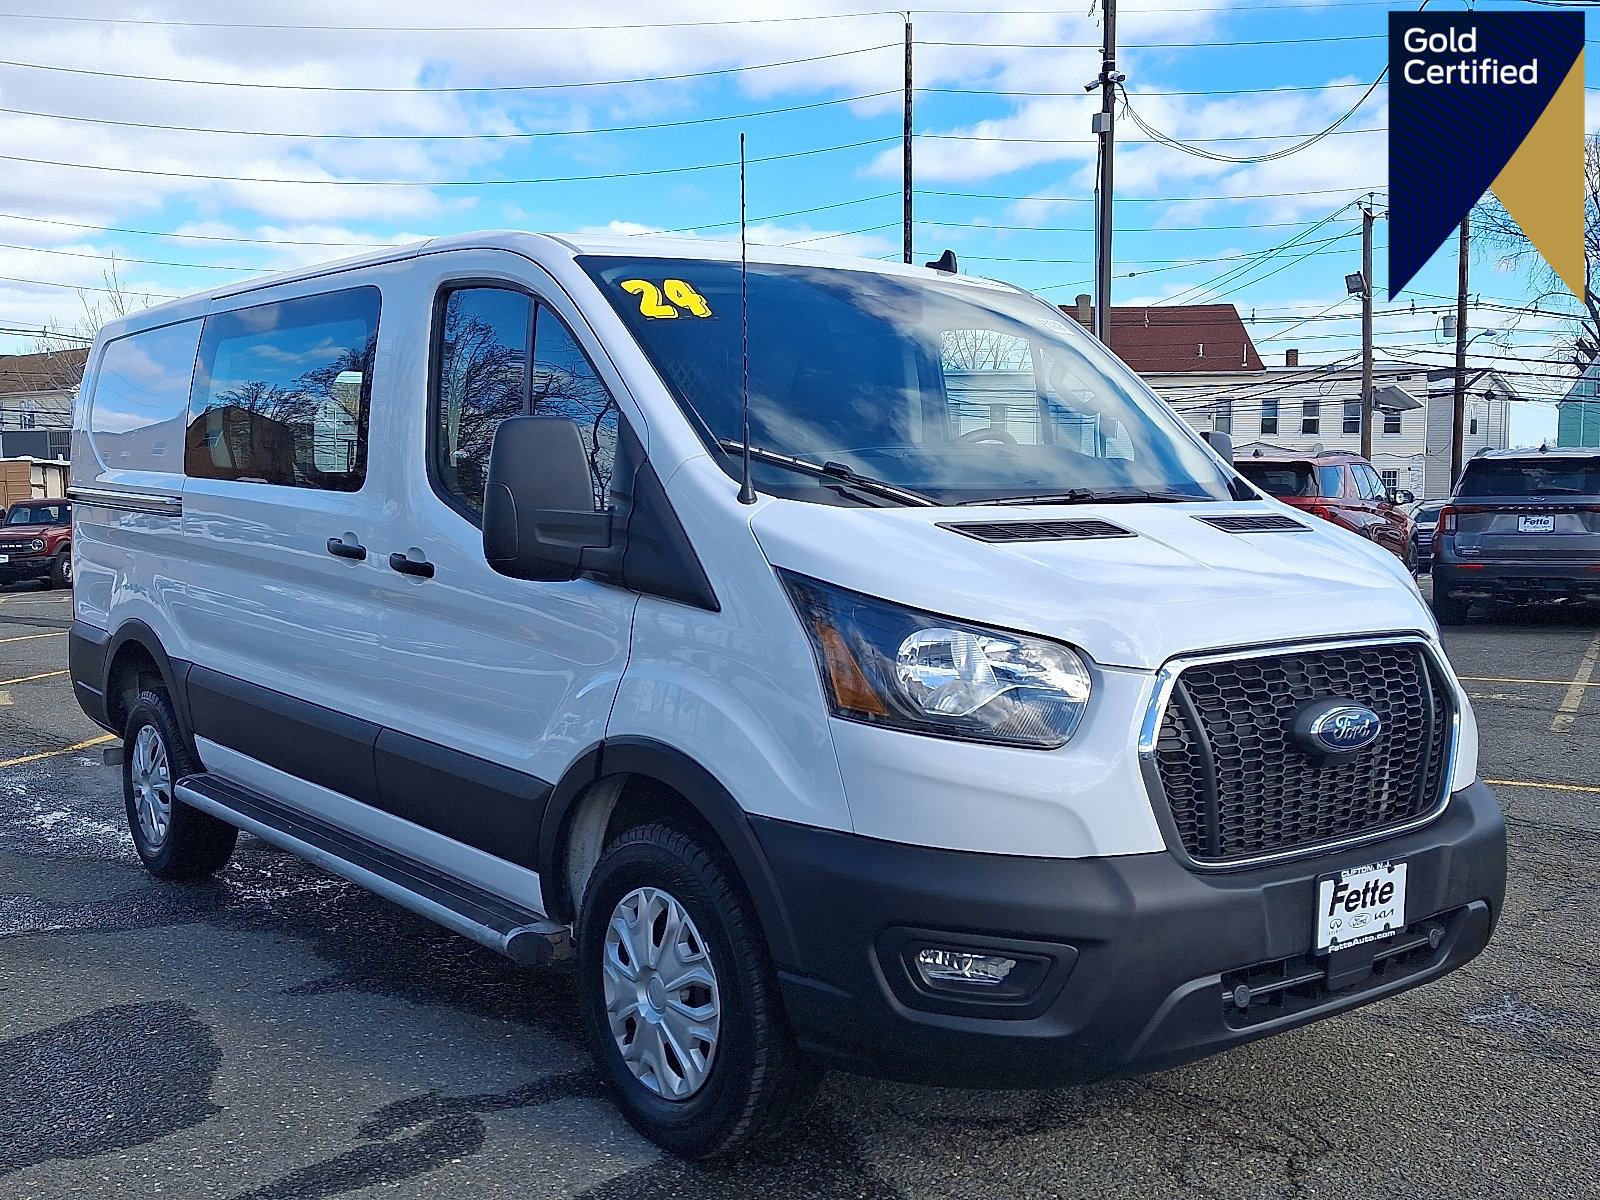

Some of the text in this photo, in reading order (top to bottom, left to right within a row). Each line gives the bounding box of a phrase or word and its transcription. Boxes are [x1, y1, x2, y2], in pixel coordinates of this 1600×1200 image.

[620, 279, 713, 319] 24
[1524, 517, 1549, 525] Fette
[1333, 714, 1371, 739] Ford
[1328, 879, 1395, 917] Fette
